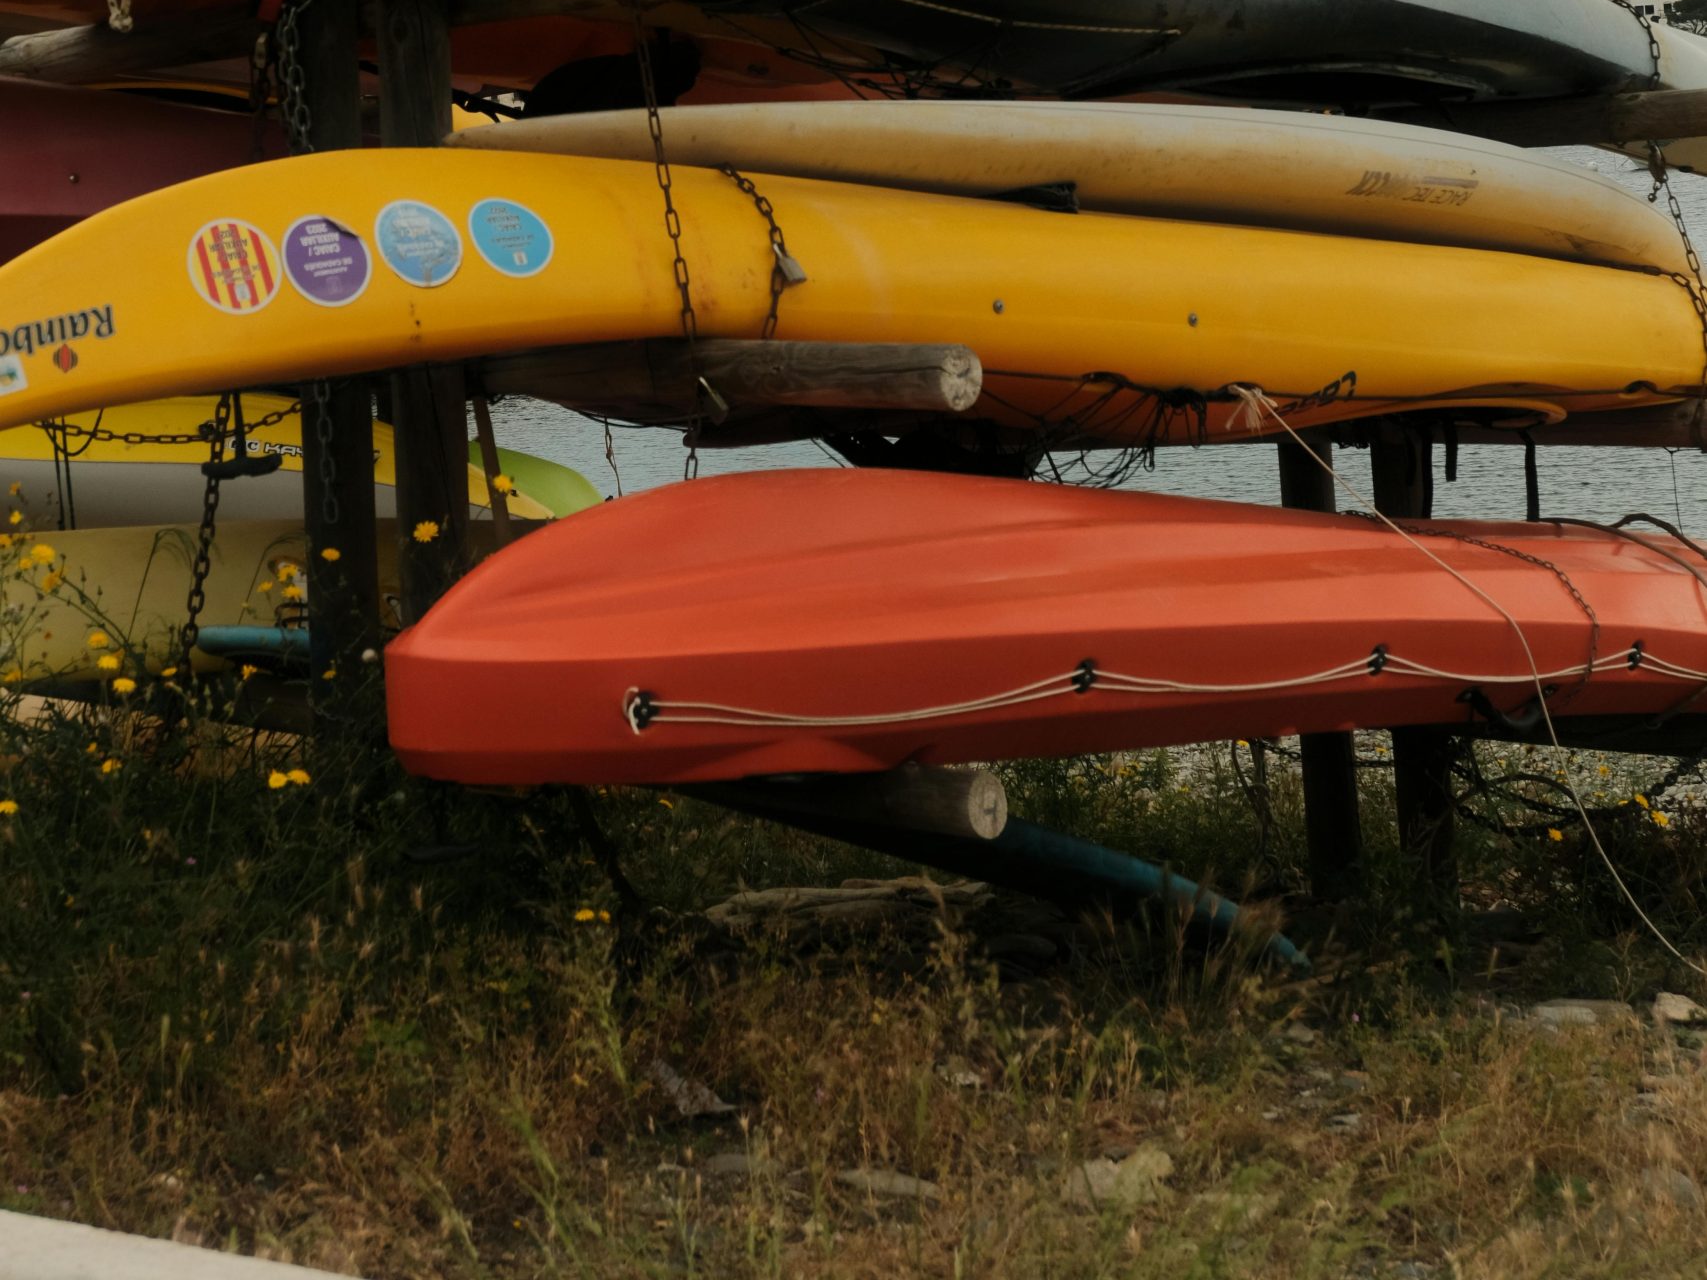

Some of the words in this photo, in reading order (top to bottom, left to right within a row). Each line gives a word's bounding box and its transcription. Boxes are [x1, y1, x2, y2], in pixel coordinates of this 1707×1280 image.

[1402, 187, 1435, 202] TEC
[1429, 189, 1473, 206] RACE
[300, 233, 339, 246] AUXILIAR
[313, 243, 340, 256] CAIAC
